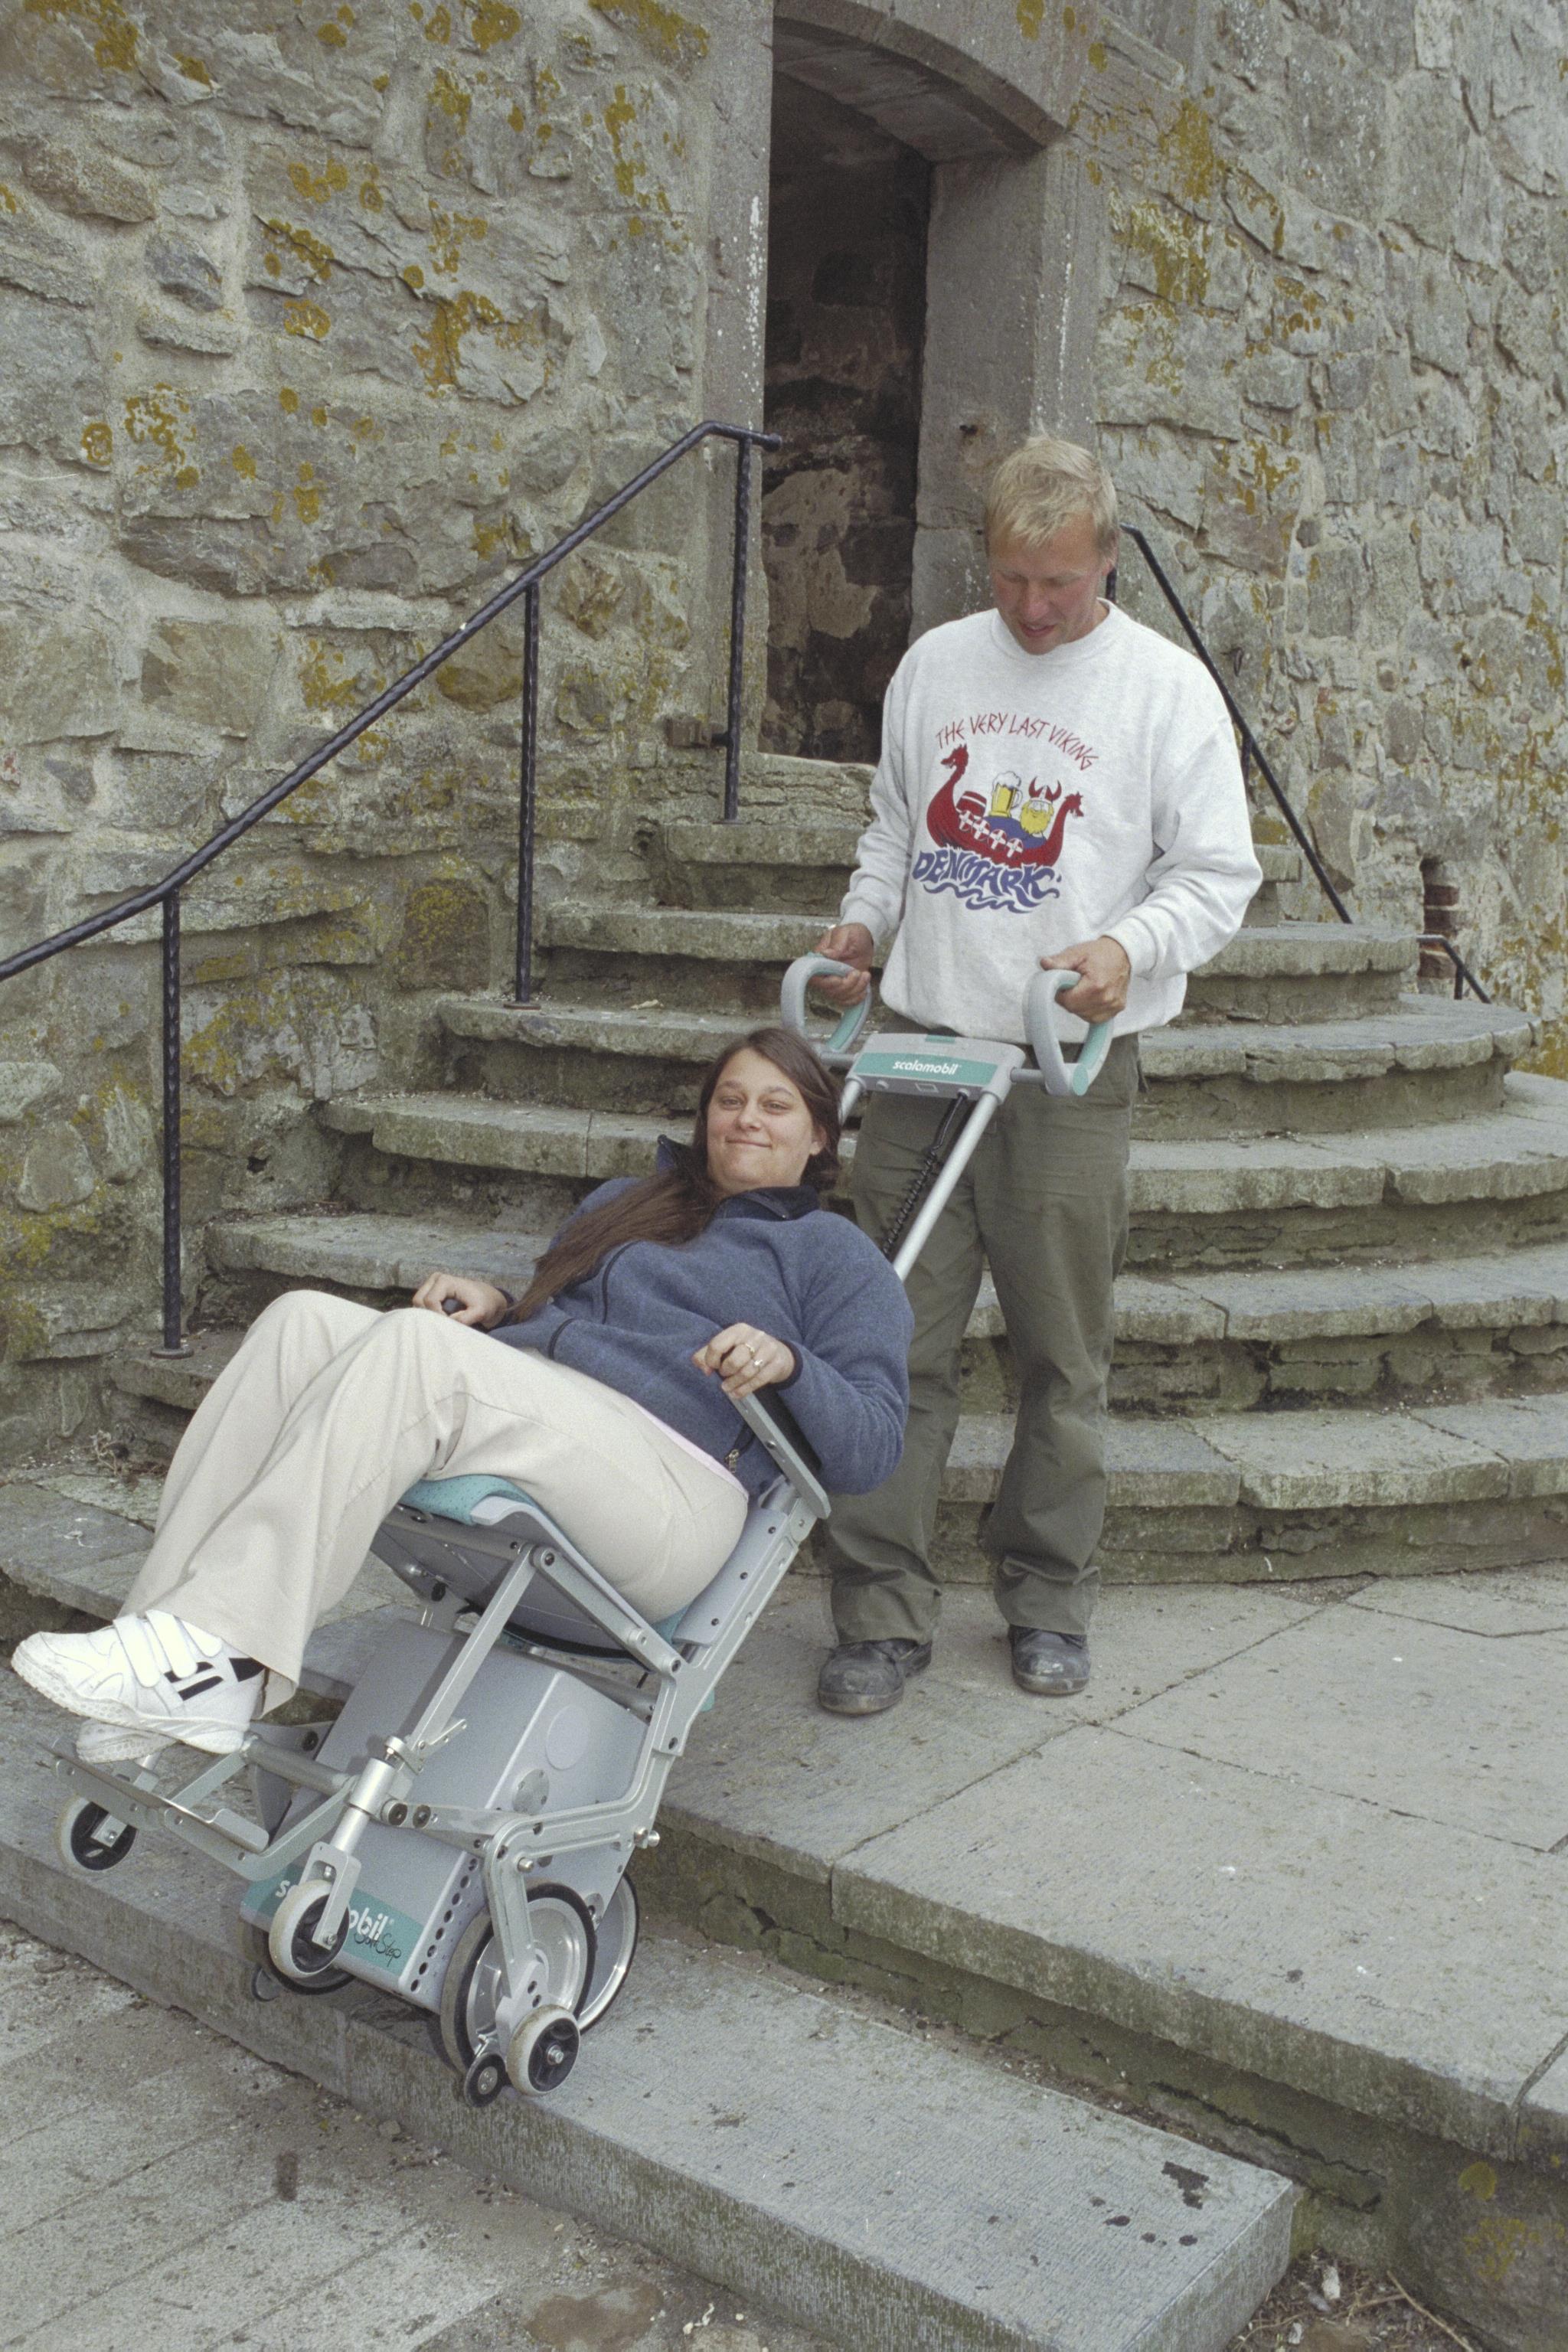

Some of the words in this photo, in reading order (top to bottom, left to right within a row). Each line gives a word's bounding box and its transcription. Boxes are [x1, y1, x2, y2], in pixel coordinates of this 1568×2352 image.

[936, 719, 965, 749] THE
[970, 712, 1008, 735] VERY
[1008, 714, 1050, 736] LAST
[1048, 724, 1099, 771] VIKING
[912, 850, 1060, 909] DENMARK
[892, 1060, 959, 1076] scalamobil
